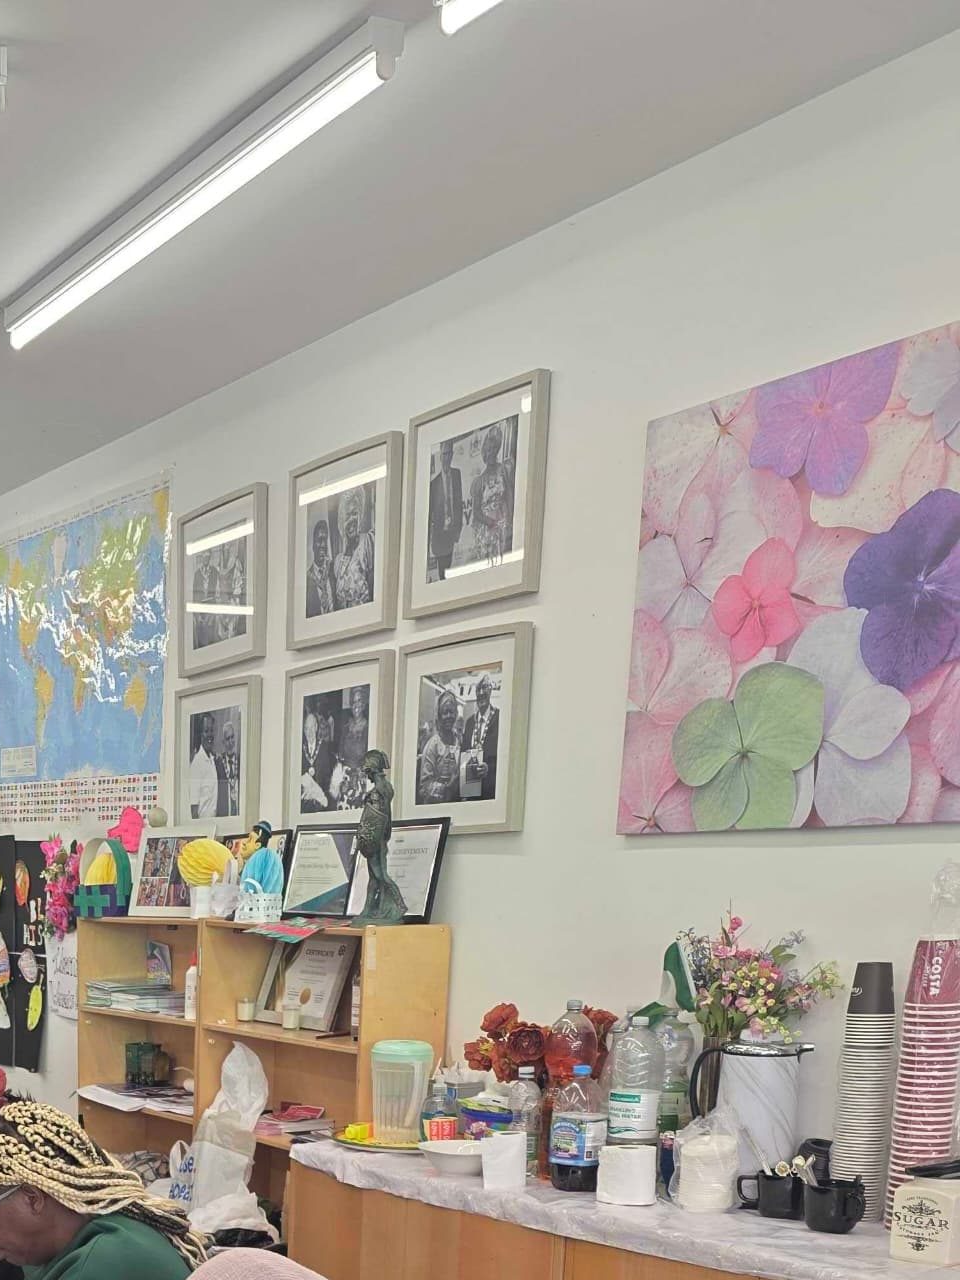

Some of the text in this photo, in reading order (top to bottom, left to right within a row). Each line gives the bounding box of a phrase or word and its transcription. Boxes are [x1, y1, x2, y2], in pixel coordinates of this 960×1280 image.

[305, 948, 336, 957] CERTIFICATE
[929, 956, 942, 996] COSTA
[893, 1211, 950, 1231] SUGAR
